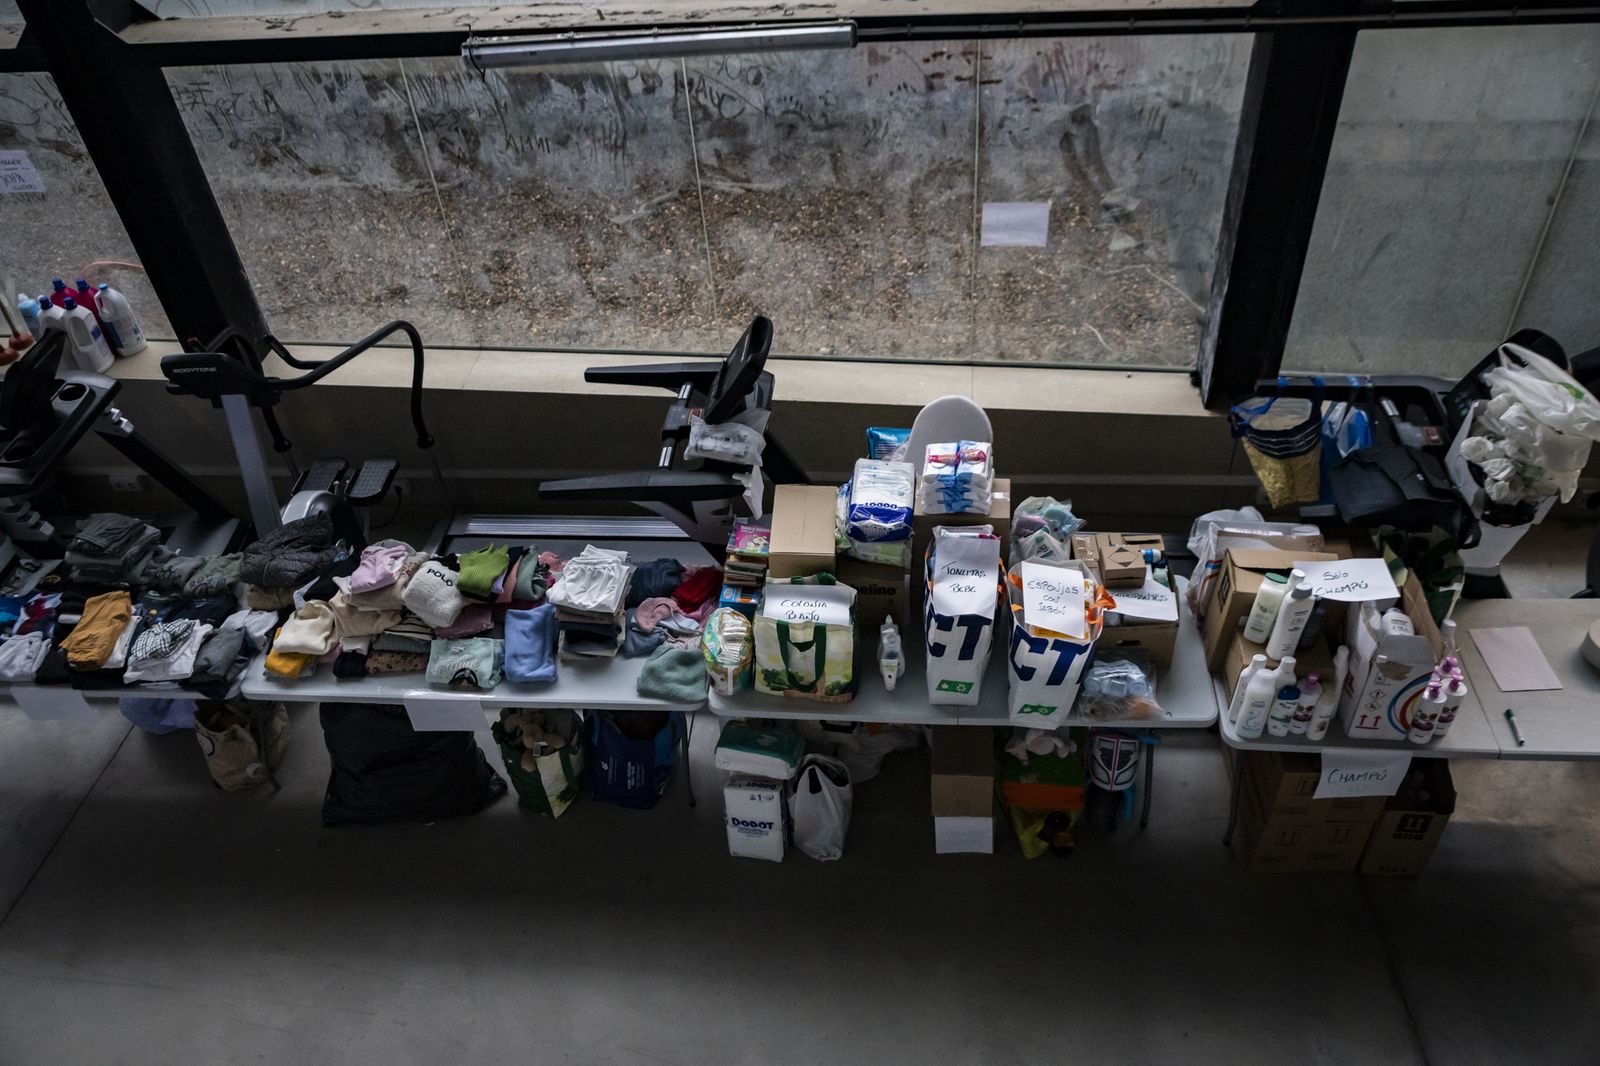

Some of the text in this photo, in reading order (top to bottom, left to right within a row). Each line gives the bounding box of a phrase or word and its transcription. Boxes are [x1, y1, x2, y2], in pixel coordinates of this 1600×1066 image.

[427, 568, 453, 587] POLO
[1027, 580, 1079, 595] ESPONJAS
[780, 600, 828, 608] COLONIA
[1327, 769, 1388, 784] CHAMPÚ
[731, 817, 774, 829] DODOT
